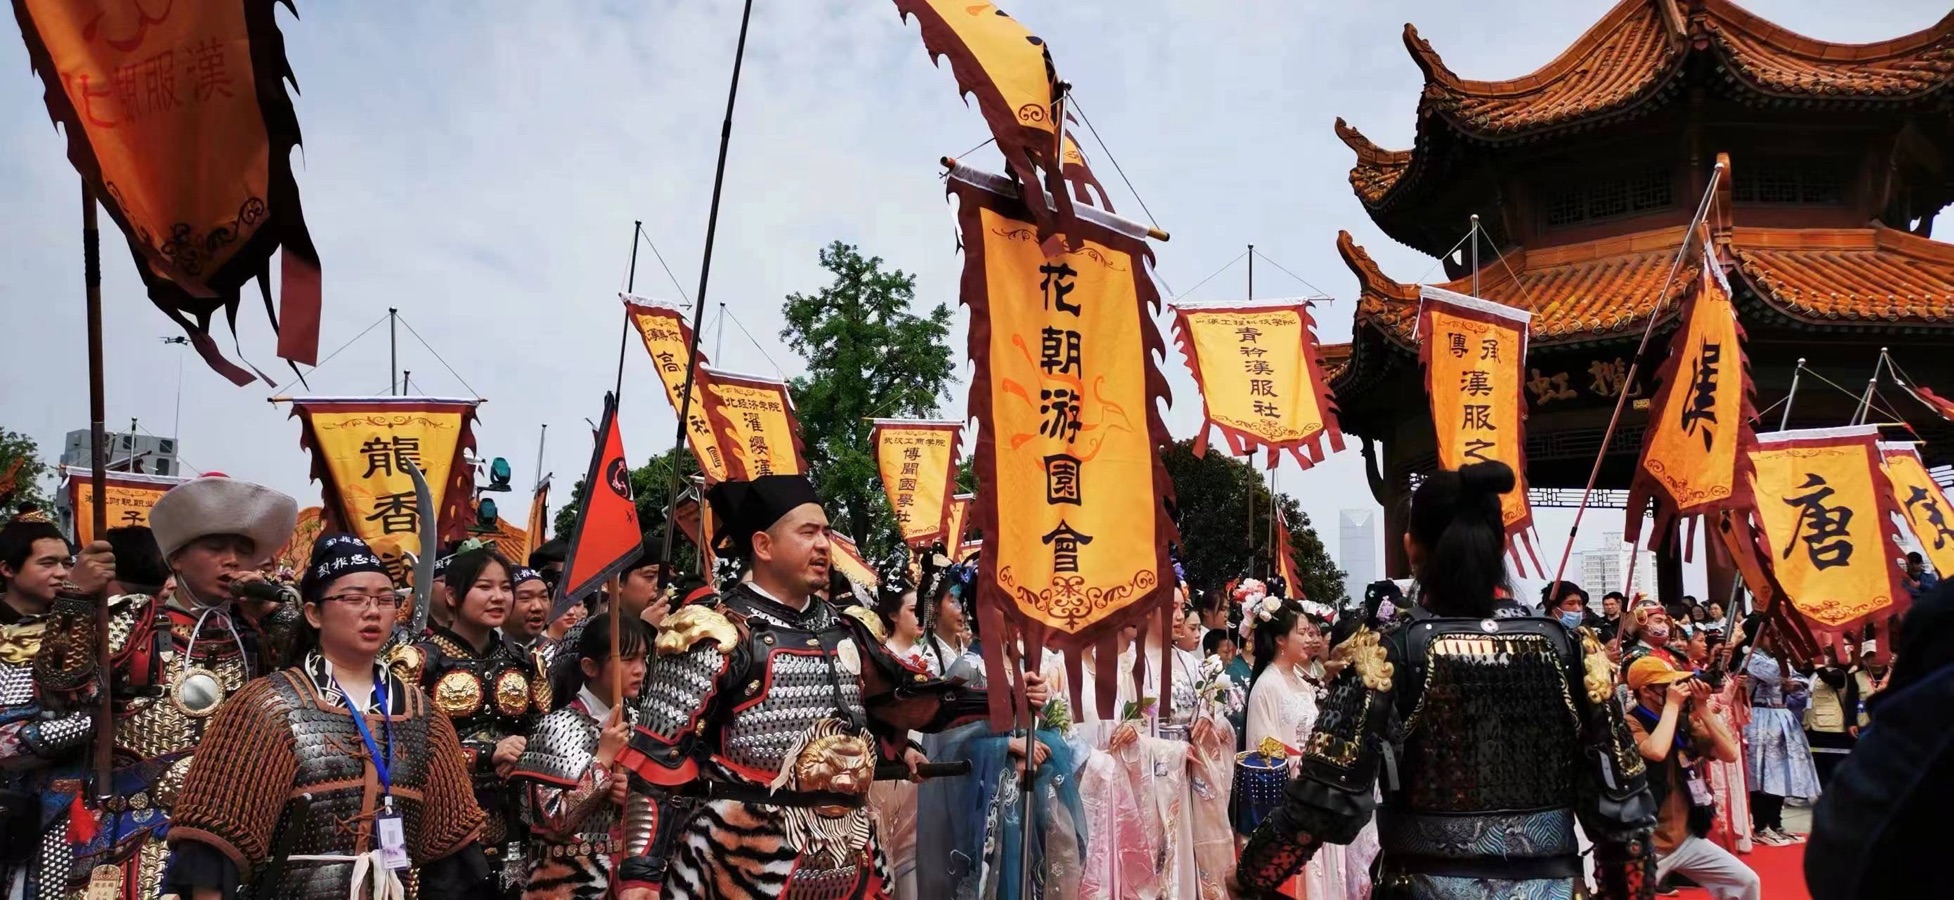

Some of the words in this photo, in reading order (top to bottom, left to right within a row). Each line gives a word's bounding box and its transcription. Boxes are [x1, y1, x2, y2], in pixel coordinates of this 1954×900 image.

[721, 396, 782, 412] 北经济学院
[1039, 261, 1093, 573] 花朝游園會
[1782, 473, 1854, 571] 唐
